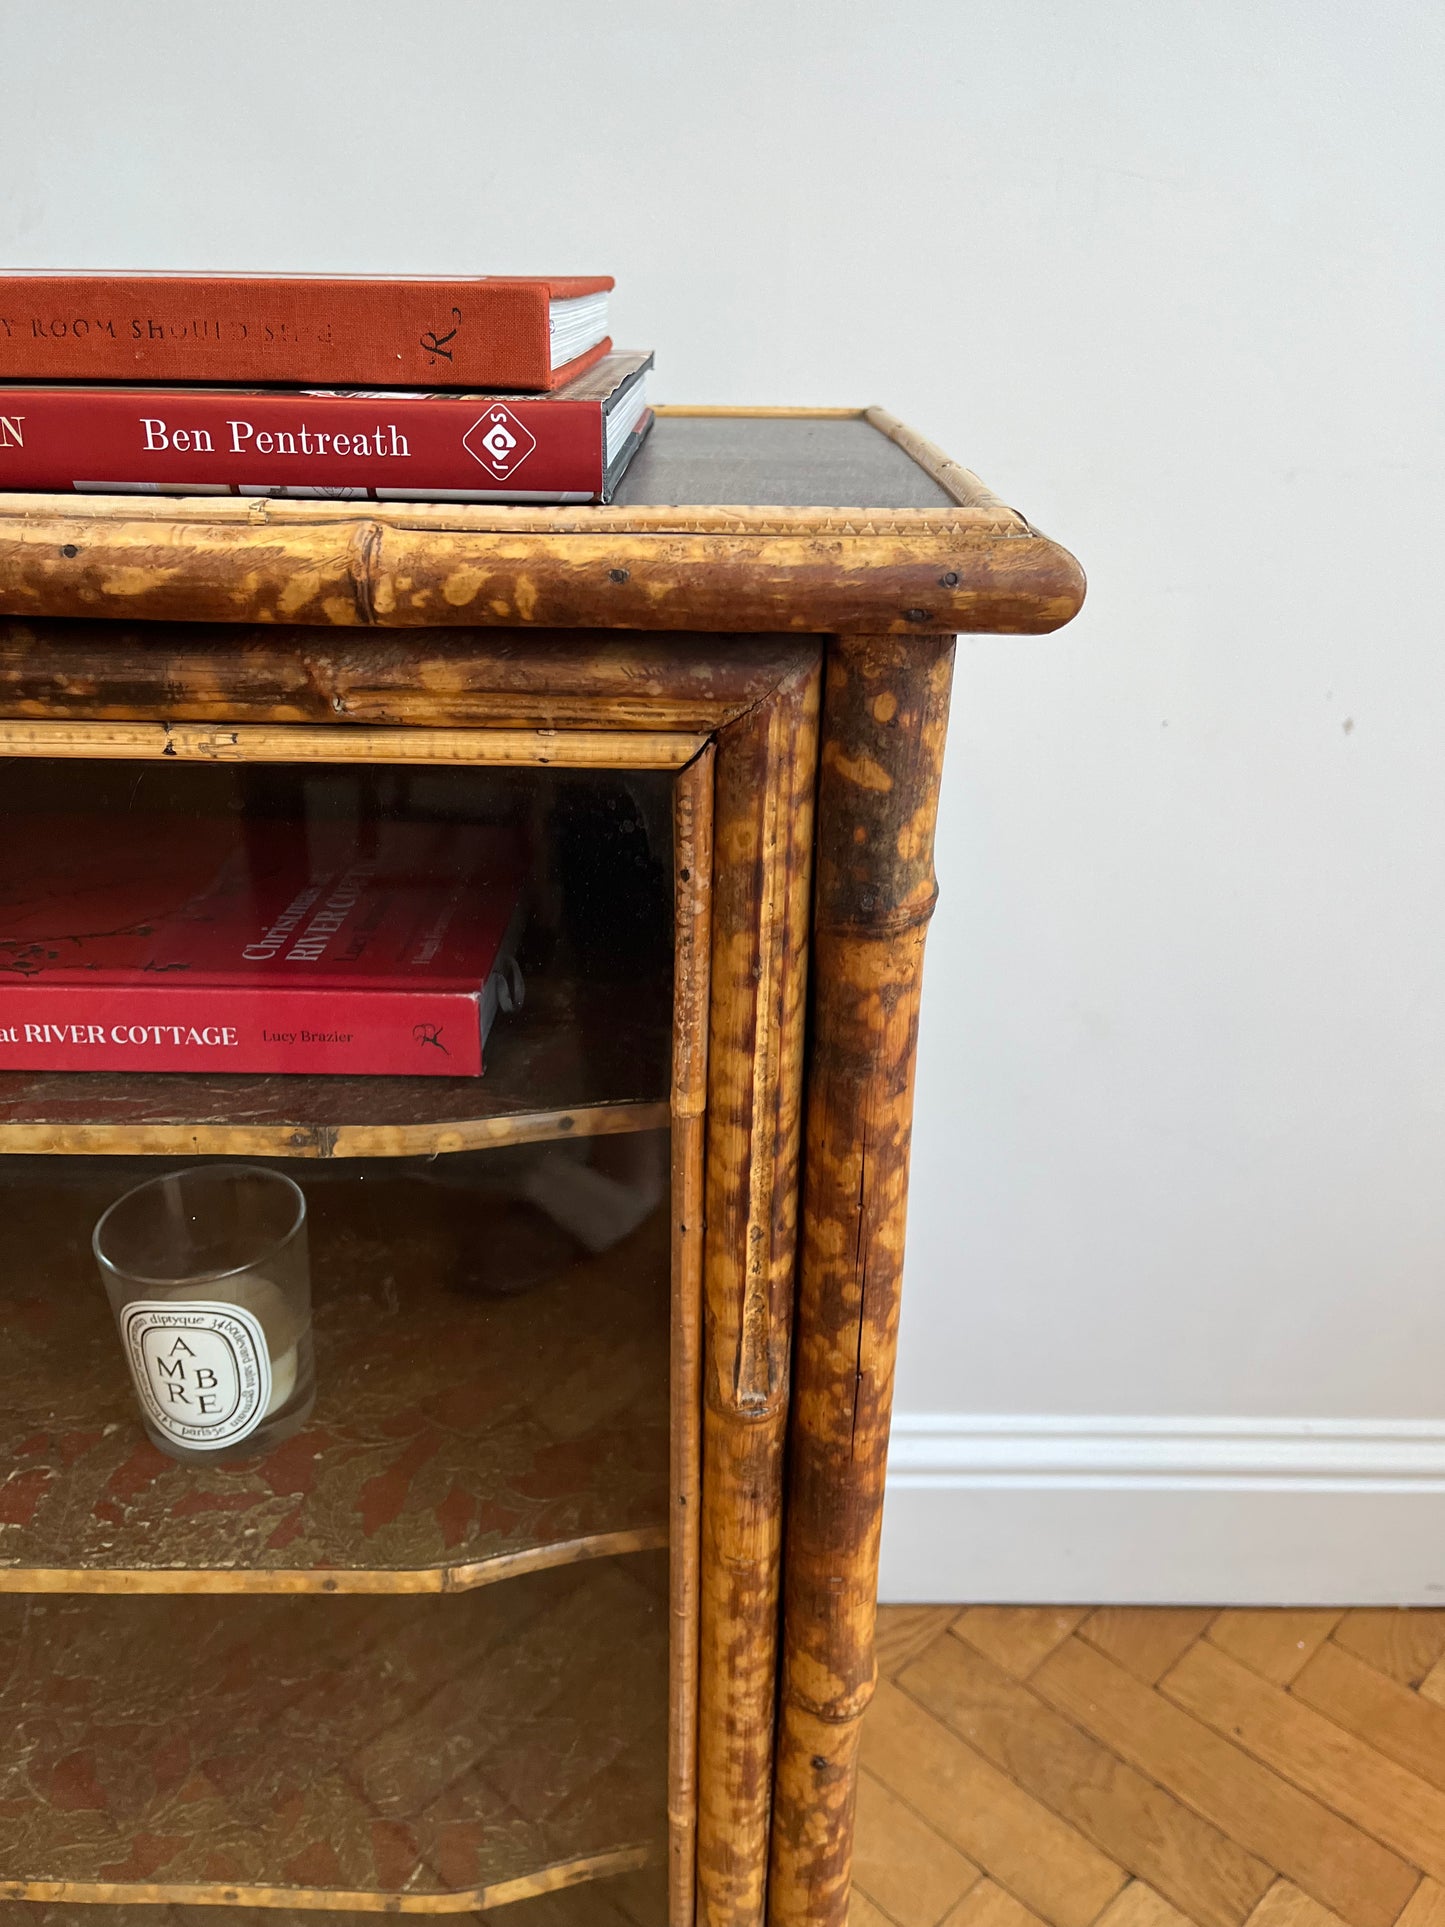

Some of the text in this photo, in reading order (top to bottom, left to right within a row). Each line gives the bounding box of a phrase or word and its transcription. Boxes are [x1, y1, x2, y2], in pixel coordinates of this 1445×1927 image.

[31, 318, 116, 339] ROOM
[140, 418, 215, 452] Ben
[226, 420, 411, 458] Pentreath
[285, 911, 349, 961] RIVER
[24, 1024, 106, 1044] RIVER
[111, 1025, 238, 1046] COTTAGE
[263, 1029, 297, 1045] Lucy
[301, 1030, 353, 1044] Brazier
[150, 1314, 205, 1326] diptyque
